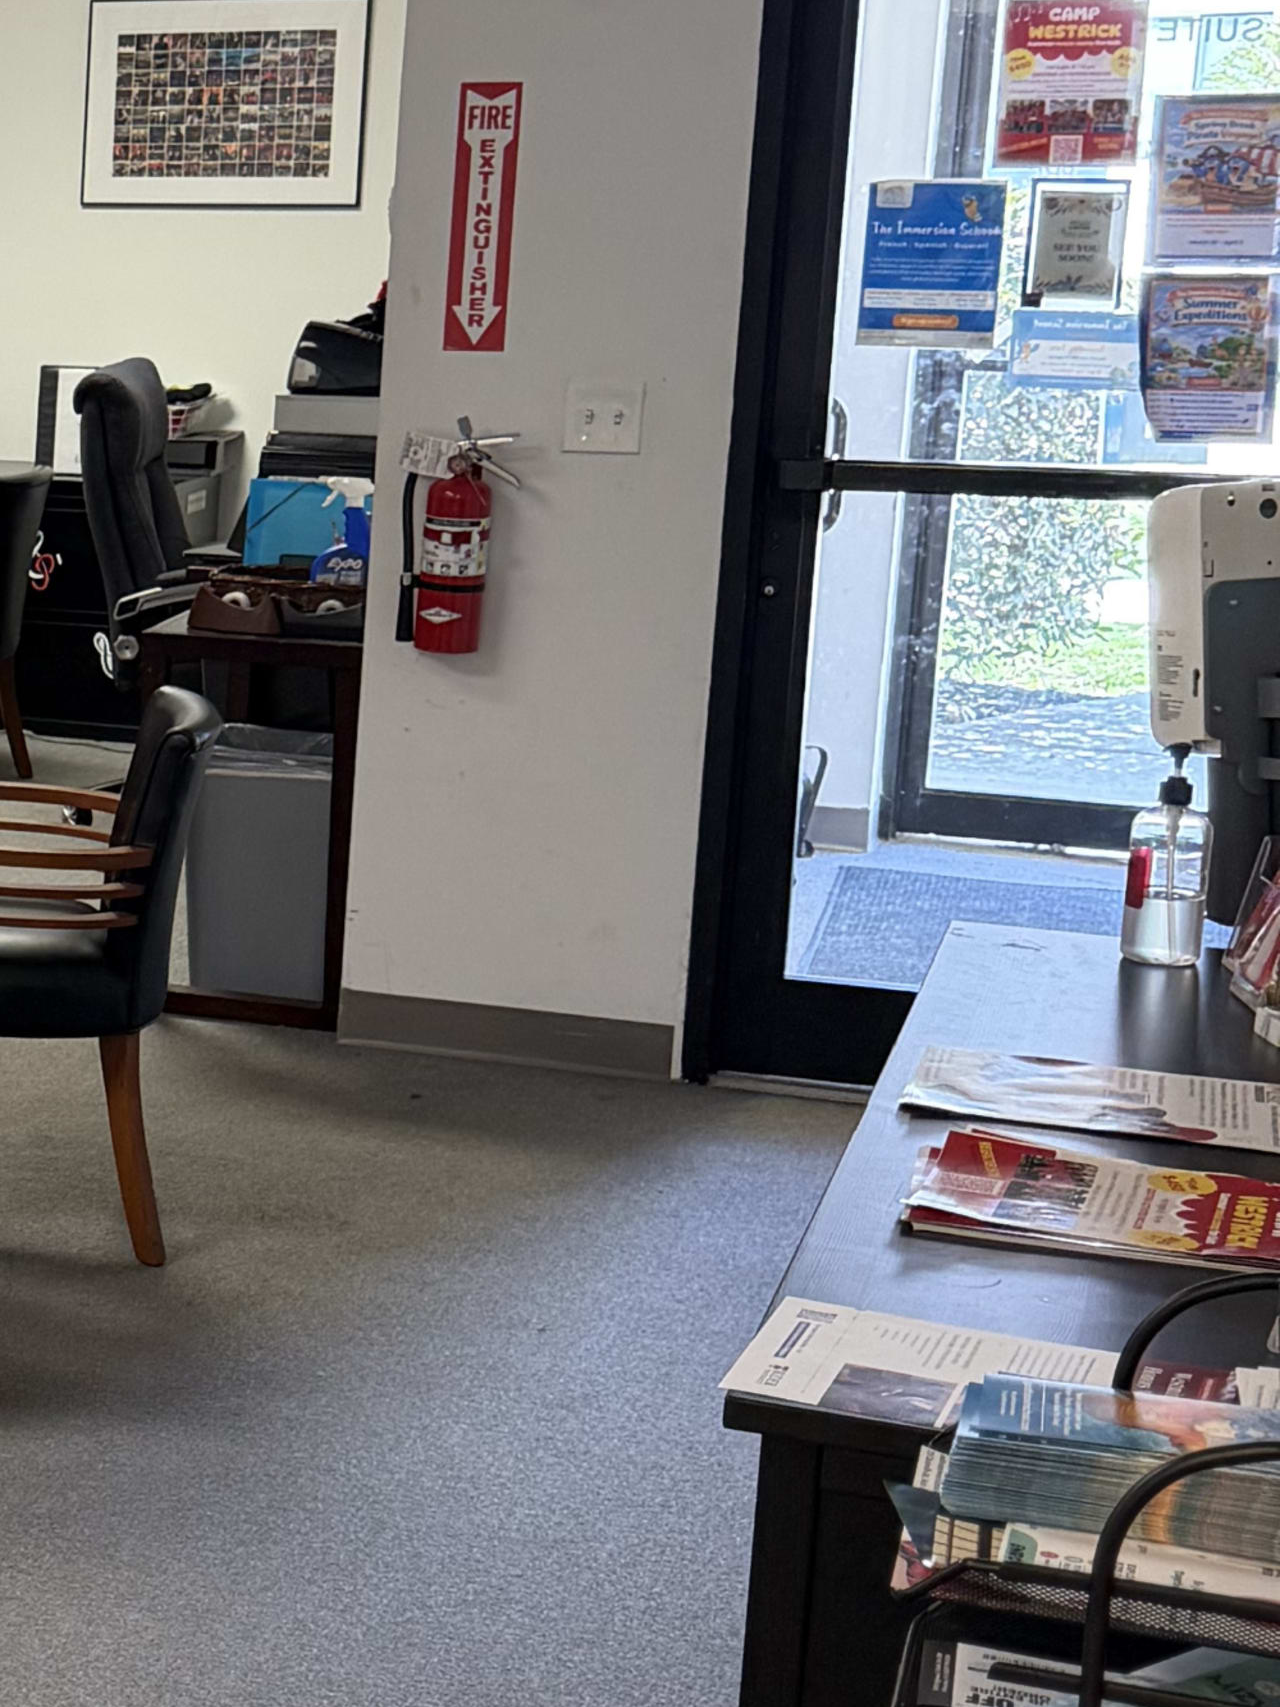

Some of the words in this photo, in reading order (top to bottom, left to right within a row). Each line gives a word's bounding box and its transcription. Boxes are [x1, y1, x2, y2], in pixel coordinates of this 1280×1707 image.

[1048, 6, 1101, 22] CAMP
[1028, 23, 1122, 40] WESTRICK
[468, 105, 512, 130] FIRE
[468, 139, 496, 328] EXTINGUISHER
[872, 221, 892, 234] The
[897, 220, 956, 236] Immersion
[1183, 297, 1238, 309] Summer
[1174, 308, 1248, 322] Expeditions
[1225, 1195, 1270, 1250] WESTRICK
